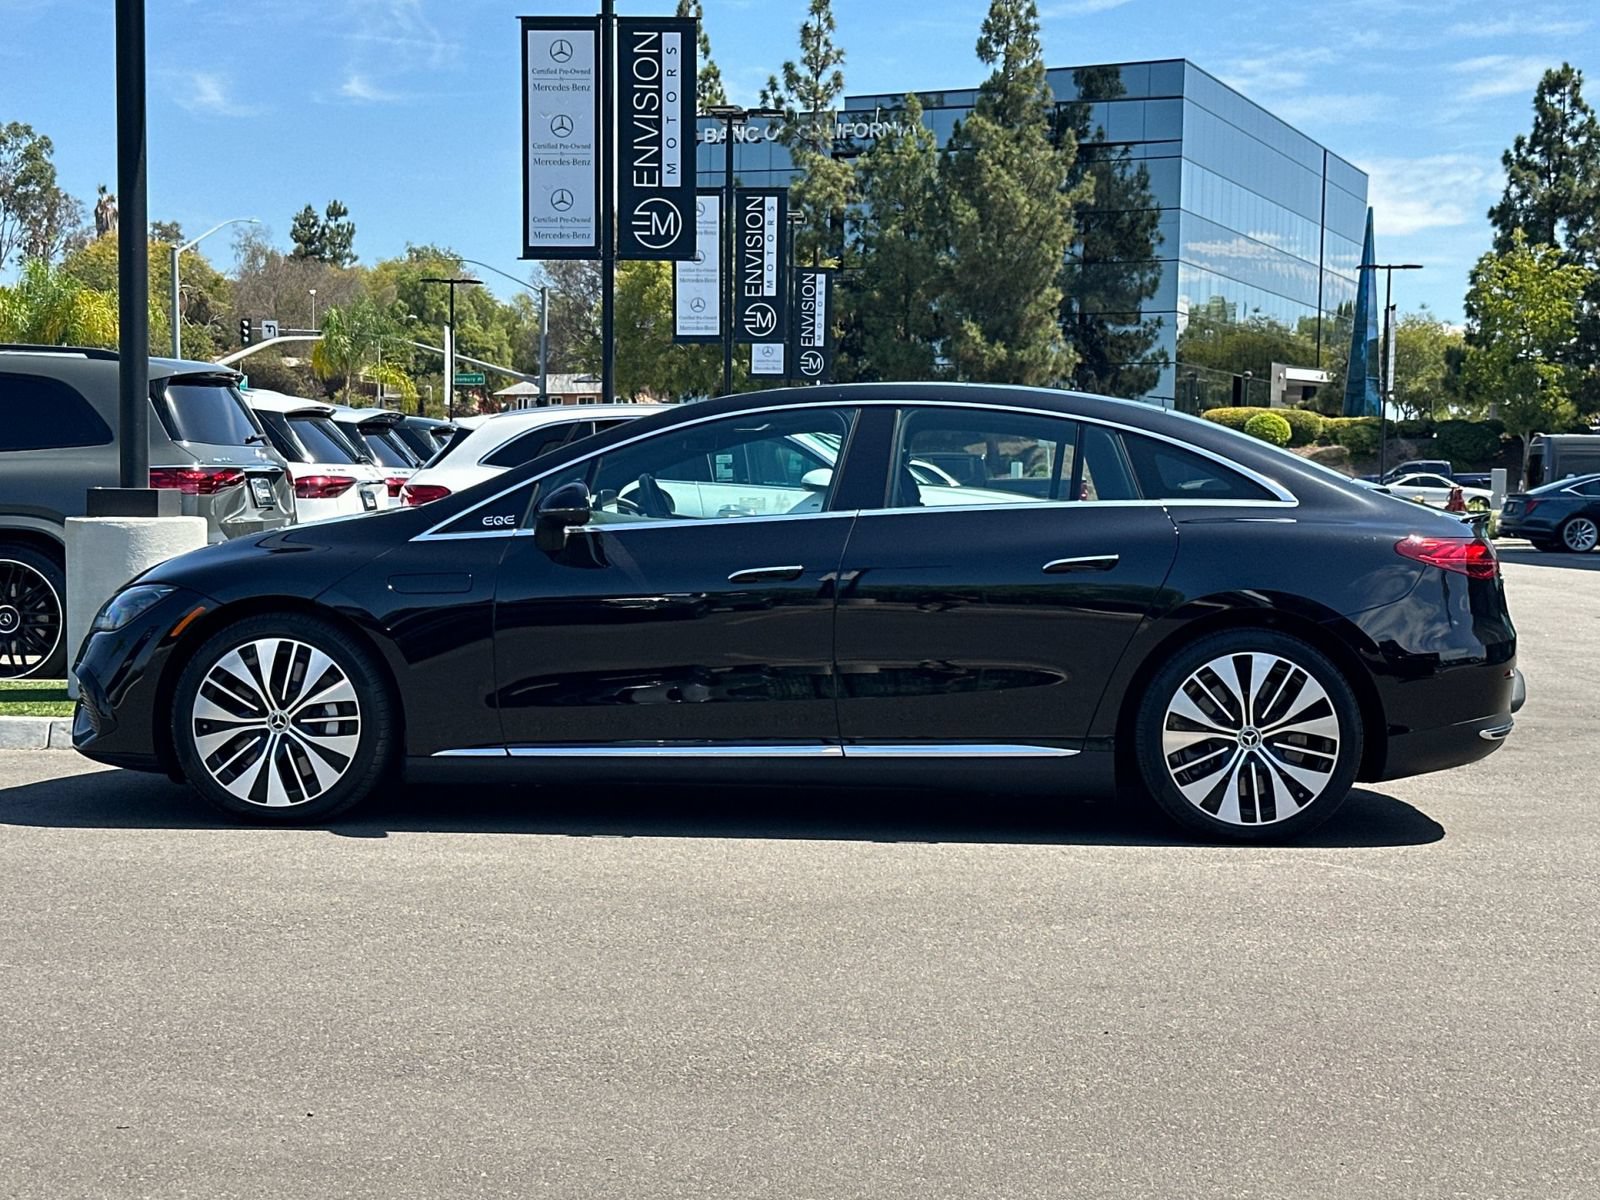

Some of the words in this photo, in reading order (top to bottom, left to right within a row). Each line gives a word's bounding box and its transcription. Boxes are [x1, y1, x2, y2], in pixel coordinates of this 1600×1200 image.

[533, 83, 591, 92] Mercedes-Benz
[633, 31, 659, 188] ENVISION
[666, 46, 677, 175] MOTORS
[704, 125, 760, 143] BANC
[533, 158, 592, 166] Mercedes-Benz
[533, 231, 591, 239] Mercedes-Benz
[744, 196, 763, 297] ENVISION
[766, 205, 775, 288] MOTORS
[800, 273, 815, 347] ENVISION
[482, 514, 515, 526] EQE
